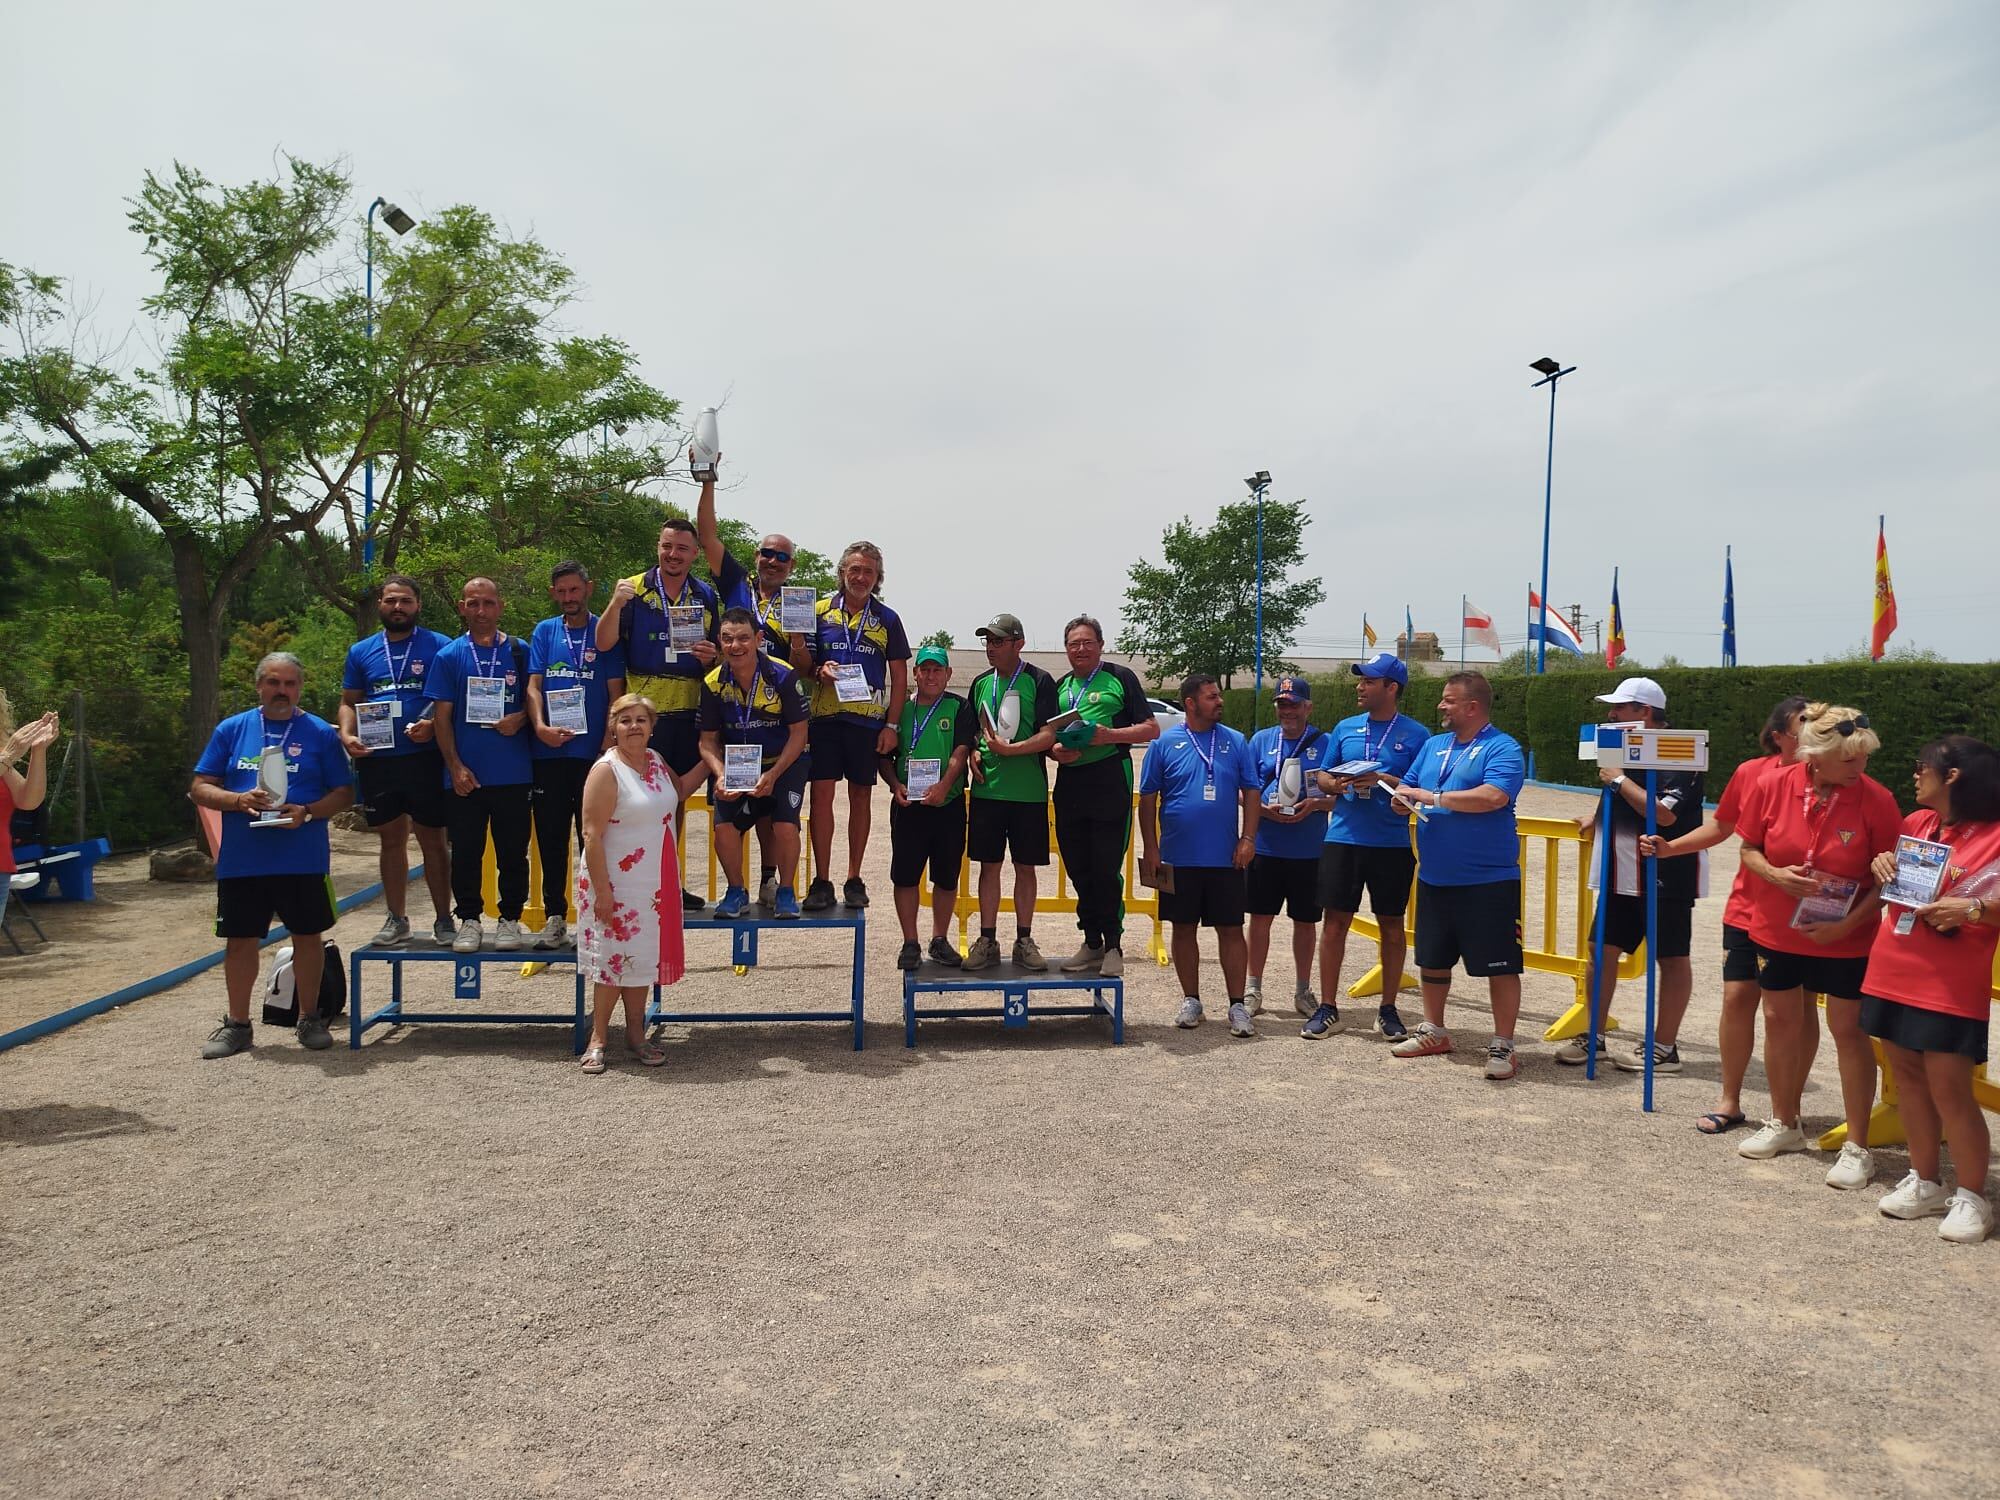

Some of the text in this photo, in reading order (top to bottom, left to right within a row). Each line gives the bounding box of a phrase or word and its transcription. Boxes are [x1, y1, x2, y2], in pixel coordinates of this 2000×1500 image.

[831, 641, 876, 655] GOORI
[739, 930, 751, 953] 1
[460, 965, 477, 988] 2
[1008, 994, 1025, 1016] 3
